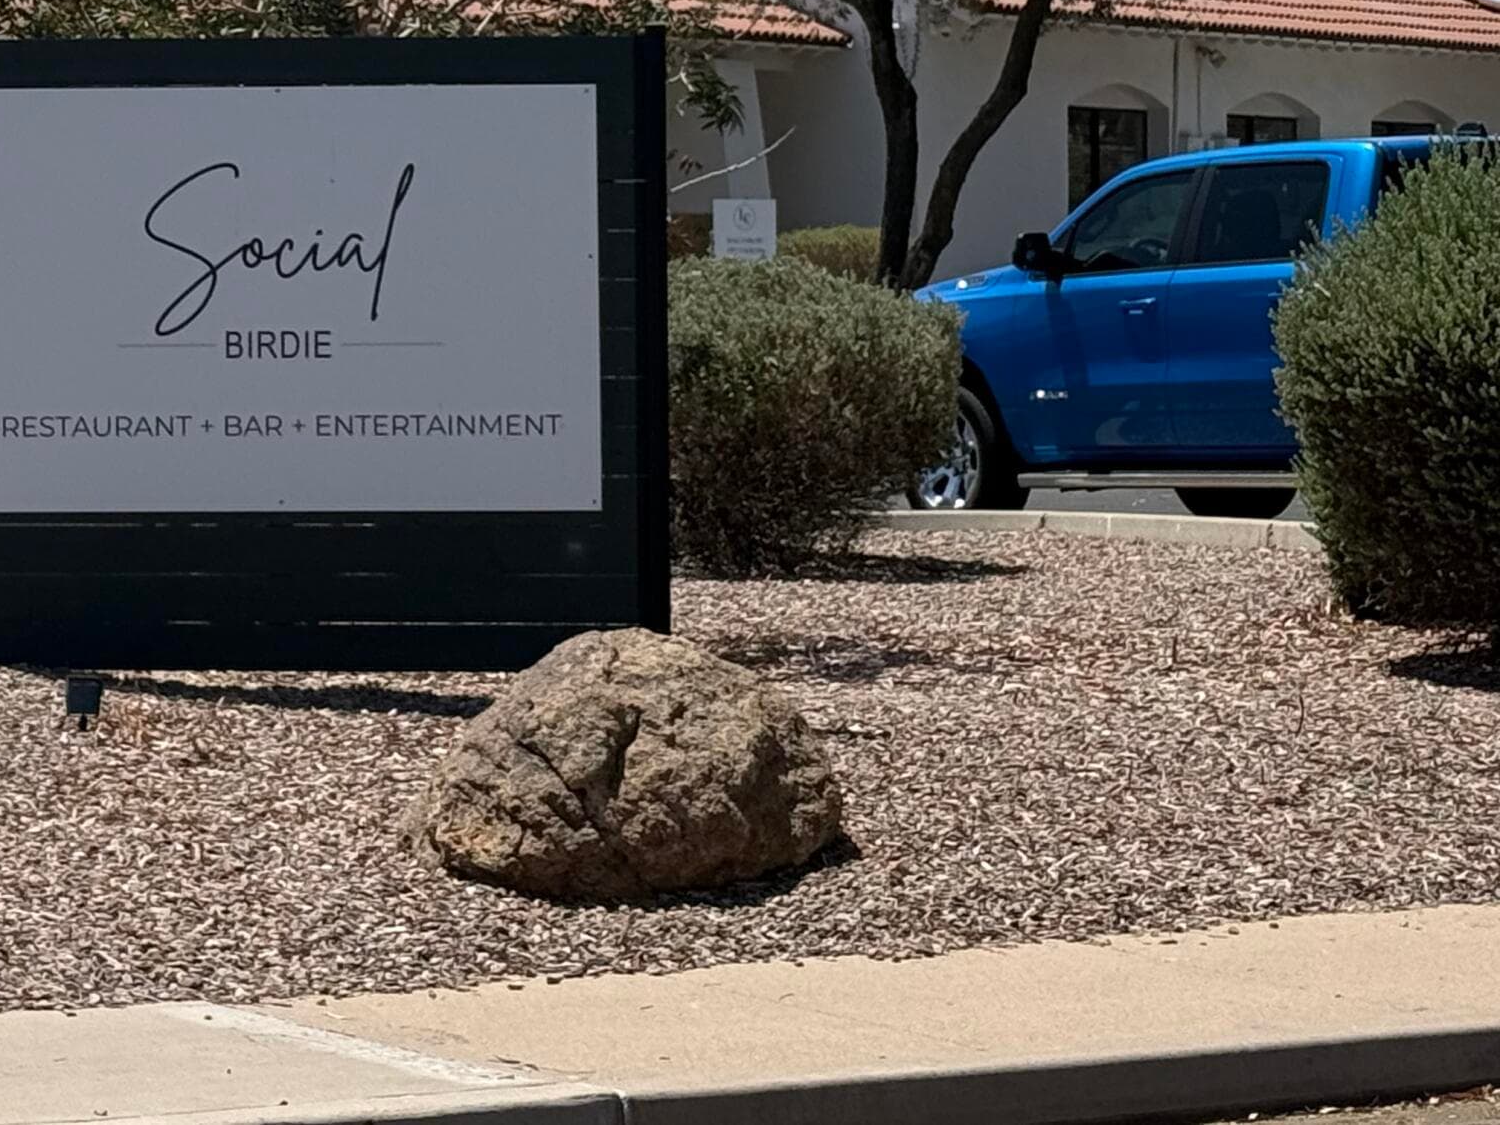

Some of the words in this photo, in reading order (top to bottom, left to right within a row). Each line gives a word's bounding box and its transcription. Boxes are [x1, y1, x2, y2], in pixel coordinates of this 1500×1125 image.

[144, 163, 414, 335] Social
[224, 330, 333, 360] BIRDIE
[2, 415, 193, 438] RESTAURANT
[224, 415, 283, 437] BAR
[315, 414, 562, 437] ENTERTAINMENT
